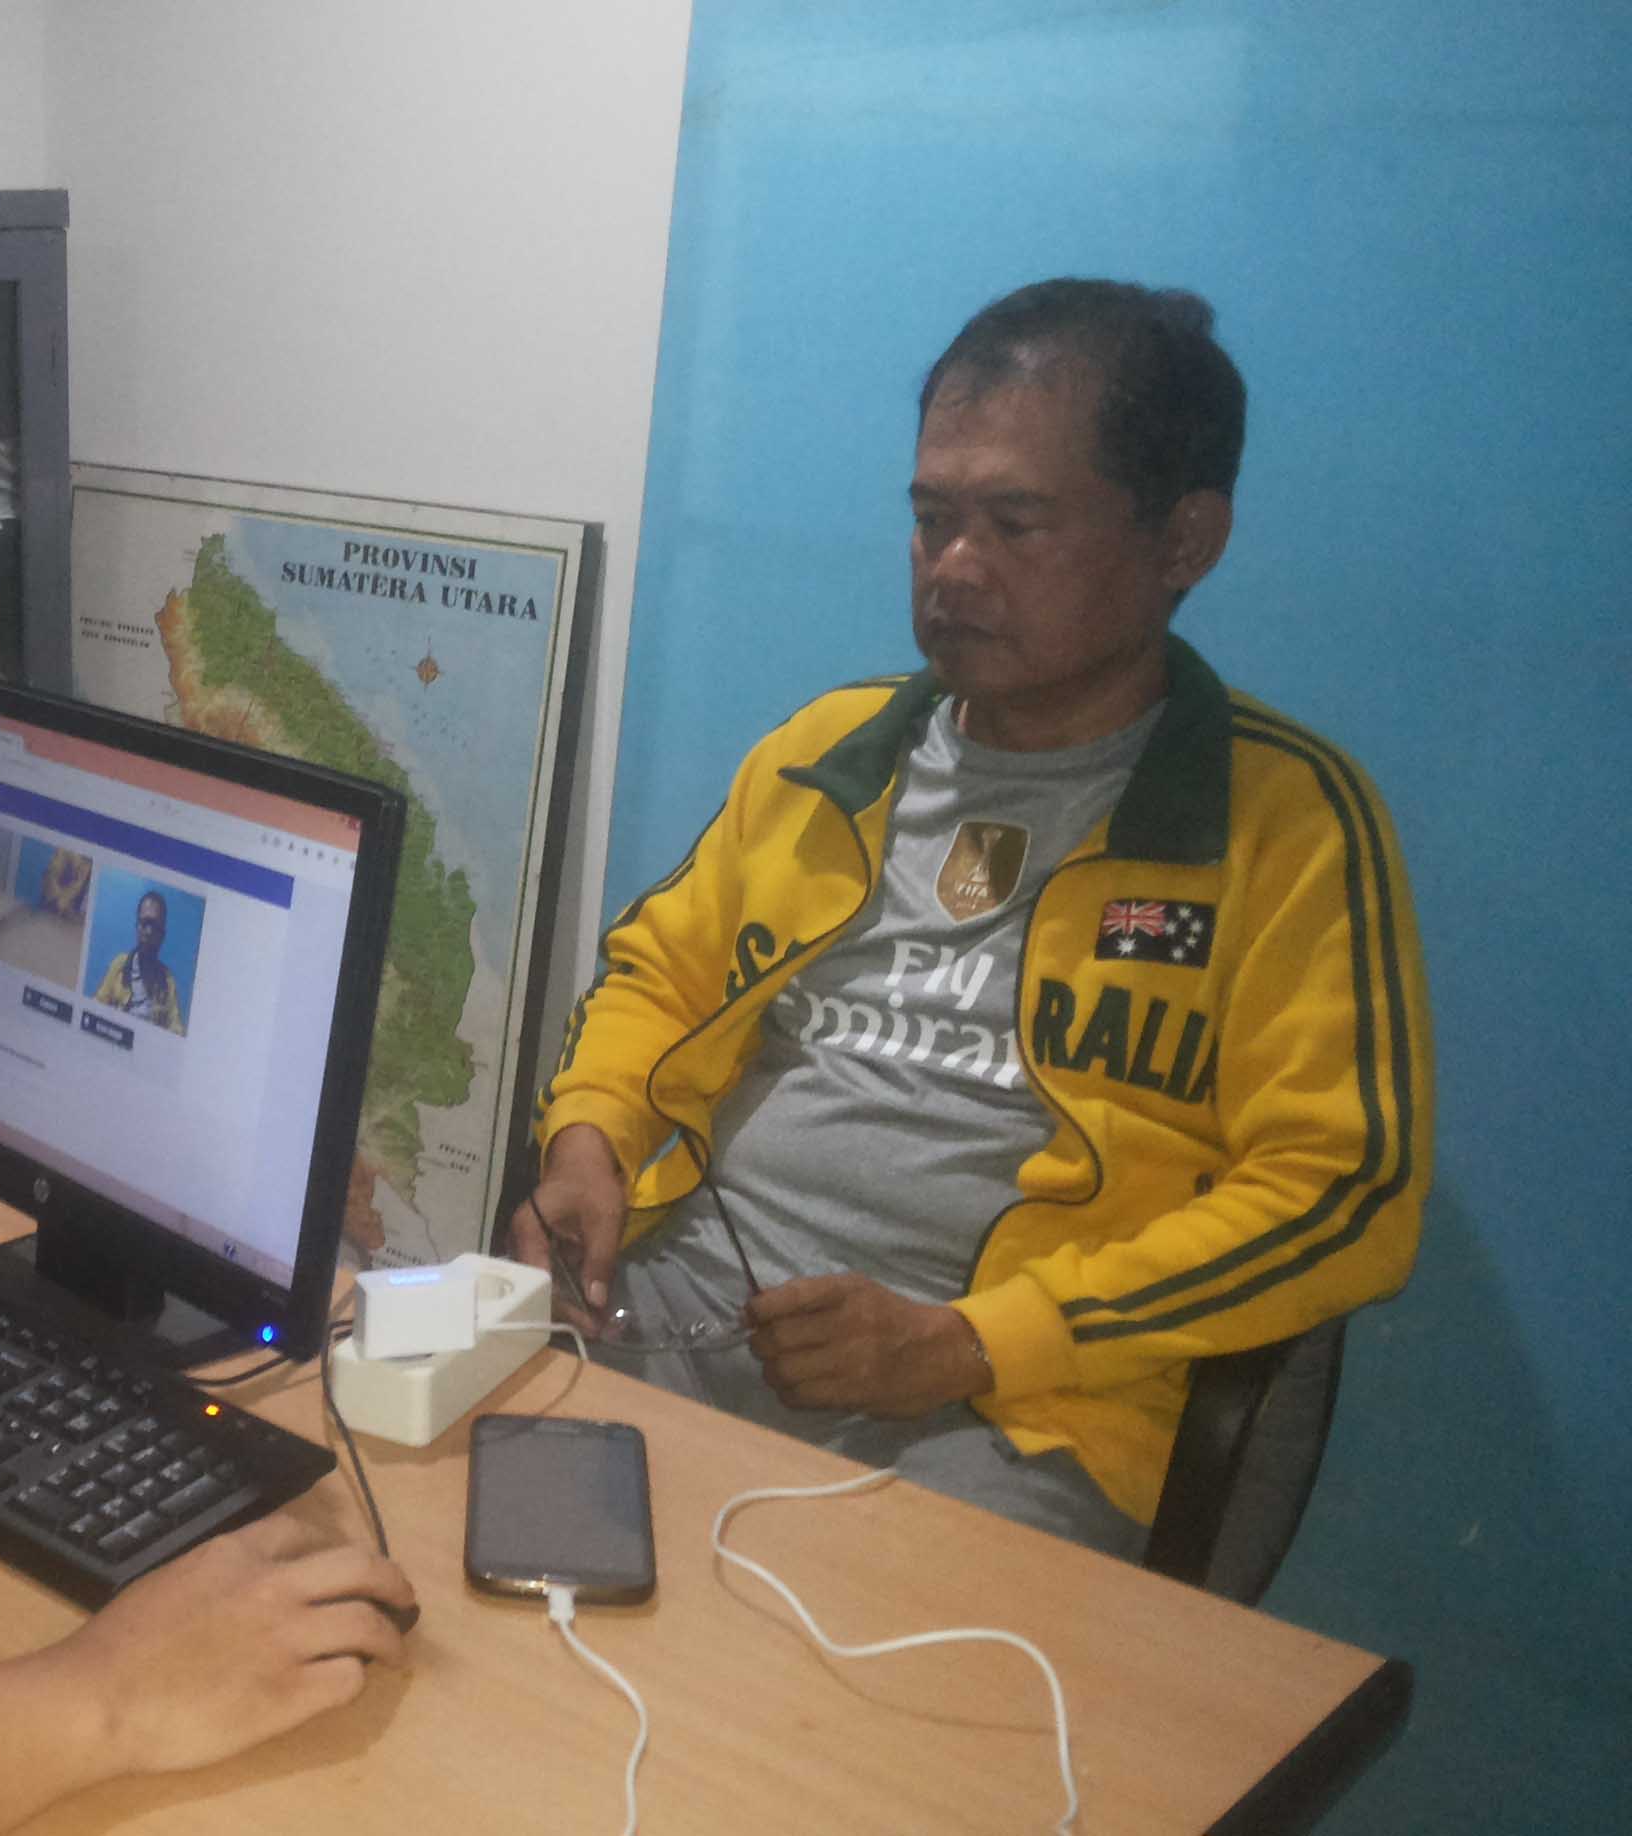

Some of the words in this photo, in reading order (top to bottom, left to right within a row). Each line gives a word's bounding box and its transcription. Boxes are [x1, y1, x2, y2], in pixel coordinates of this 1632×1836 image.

[342, 541, 477, 580] PROVINSI
[281, 562, 426, 603] SUMATERA
[441, 586, 538, 620] UTARA
[884, 940, 994, 1011] Fly
